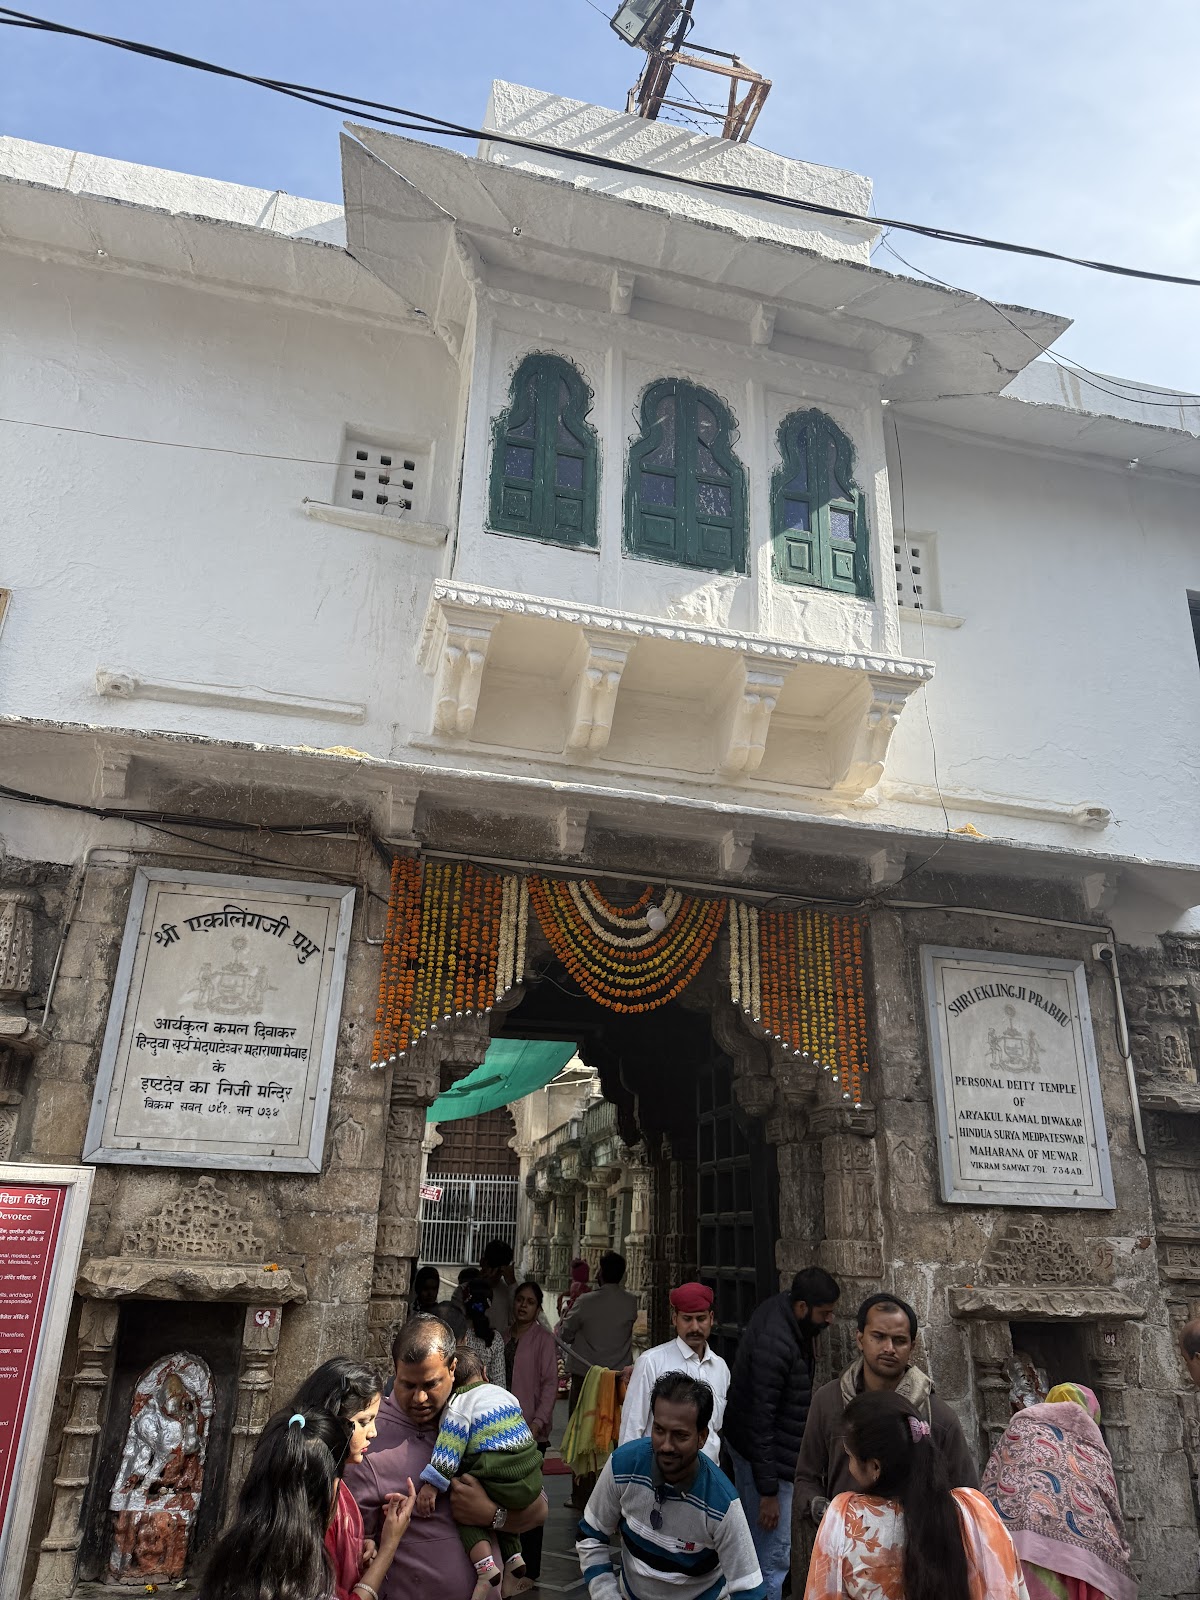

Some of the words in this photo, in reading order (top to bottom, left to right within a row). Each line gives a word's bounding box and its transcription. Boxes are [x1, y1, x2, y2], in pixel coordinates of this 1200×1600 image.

[154, 923, 181, 947] श्री
[183, 904, 290, 938] एकलिंगजी
[287, 930, 321, 964] प्रभु
[948, 990, 976, 1018] SHRI
[973, 983, 1026, 1001] EKLINGJI
[1028, 989, 1071, 1028] PRABHU
[153, 1014, 209, 1036] आर्यकुल
[213, 1022, 249, 1036] कमल
[254, 1021, 297, 1040] दिवाकर
[172, 1035, 194, 1055] सूर्य
[244, 1044, 282, 1058] महाराणा
[283, 1043, 309, 1062] मेवाड़
[212, 1059, 226, 1073] के
[140, 1075, 184, 1096] इष्टदेव
[189, 1080, 211, 1095] का
[216, 1078, 252, 1097] निजी
[257, 1081, 293, 1103] मन्दिर
[955, 1076, 1004, 1089] PERSONAL
[1007, 1080, 1035, 1091] DEITY
[1039, 1082, 1077, 1094] TEMPLE
[143, 1096, 174, 1110] विक्रम
[237, 1105, 254, 1117] सन्
[257, 1107, 280, 1119] ७३४
[1013, 1096, 1026, 1107] OF
[958, 1110, 1003, 1122] ARYAKUL
[1005, 1113, 1040, 1125] KAMAL
[1041, 1115, 1083, 1127] DIWAKAR
[959, 1127, 992, 1139] HINDUA
[994, 1129, 1020, 1141] SURYA
[1022, 1131, 1085, 1144] MEDPATESWAR
[969, 1145, 1025, 1158] MAHARANA
[1027, 1149, 1040, 1159] OF
[970, 1161, 1000, 1171] VIKRAM
[1002, 1163, 1030, 1173] SAMVAT
[24, 1193, 51, 1206] निर्देश
